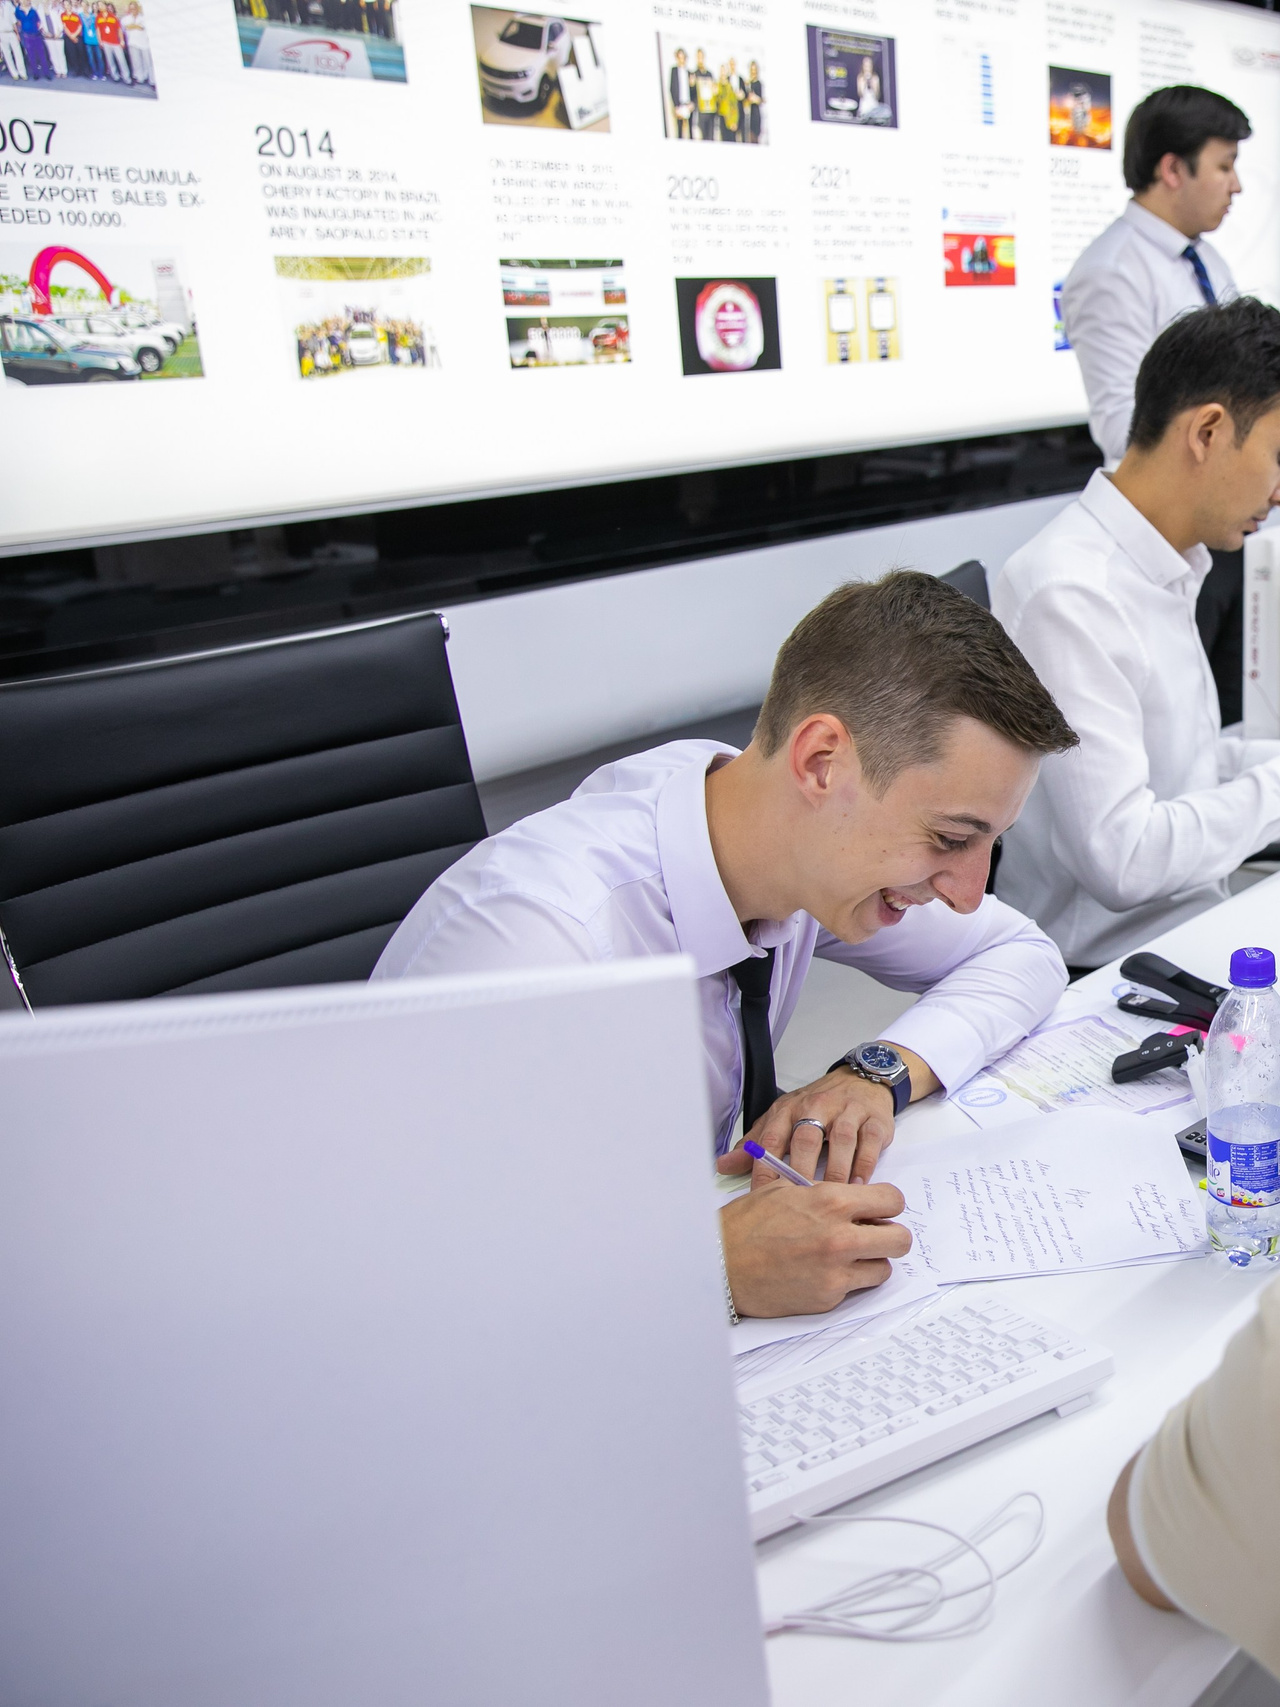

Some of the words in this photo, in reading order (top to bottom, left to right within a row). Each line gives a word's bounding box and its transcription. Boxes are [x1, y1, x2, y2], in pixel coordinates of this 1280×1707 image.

[0, 118, 57, 155] 07
[255, 124, 335, 160] 2014
[84, 164, 121, 183] THE
[126, 167, 201, 187] CUMULA-
[259, 162, 282, 177] ON
[286, 165, 341, 180] AUGUST
[810, 164, 851, 189] 2021
[23, 185, 98, 204] EXPORT
[111, 188, 167, 207] SALES
[262, 184, 312, 200] CHERY
[317, 186, 380, 203] FACTORY
[667, 174, 719, 202] 2020
[265, 206, 299, 220] WAS
